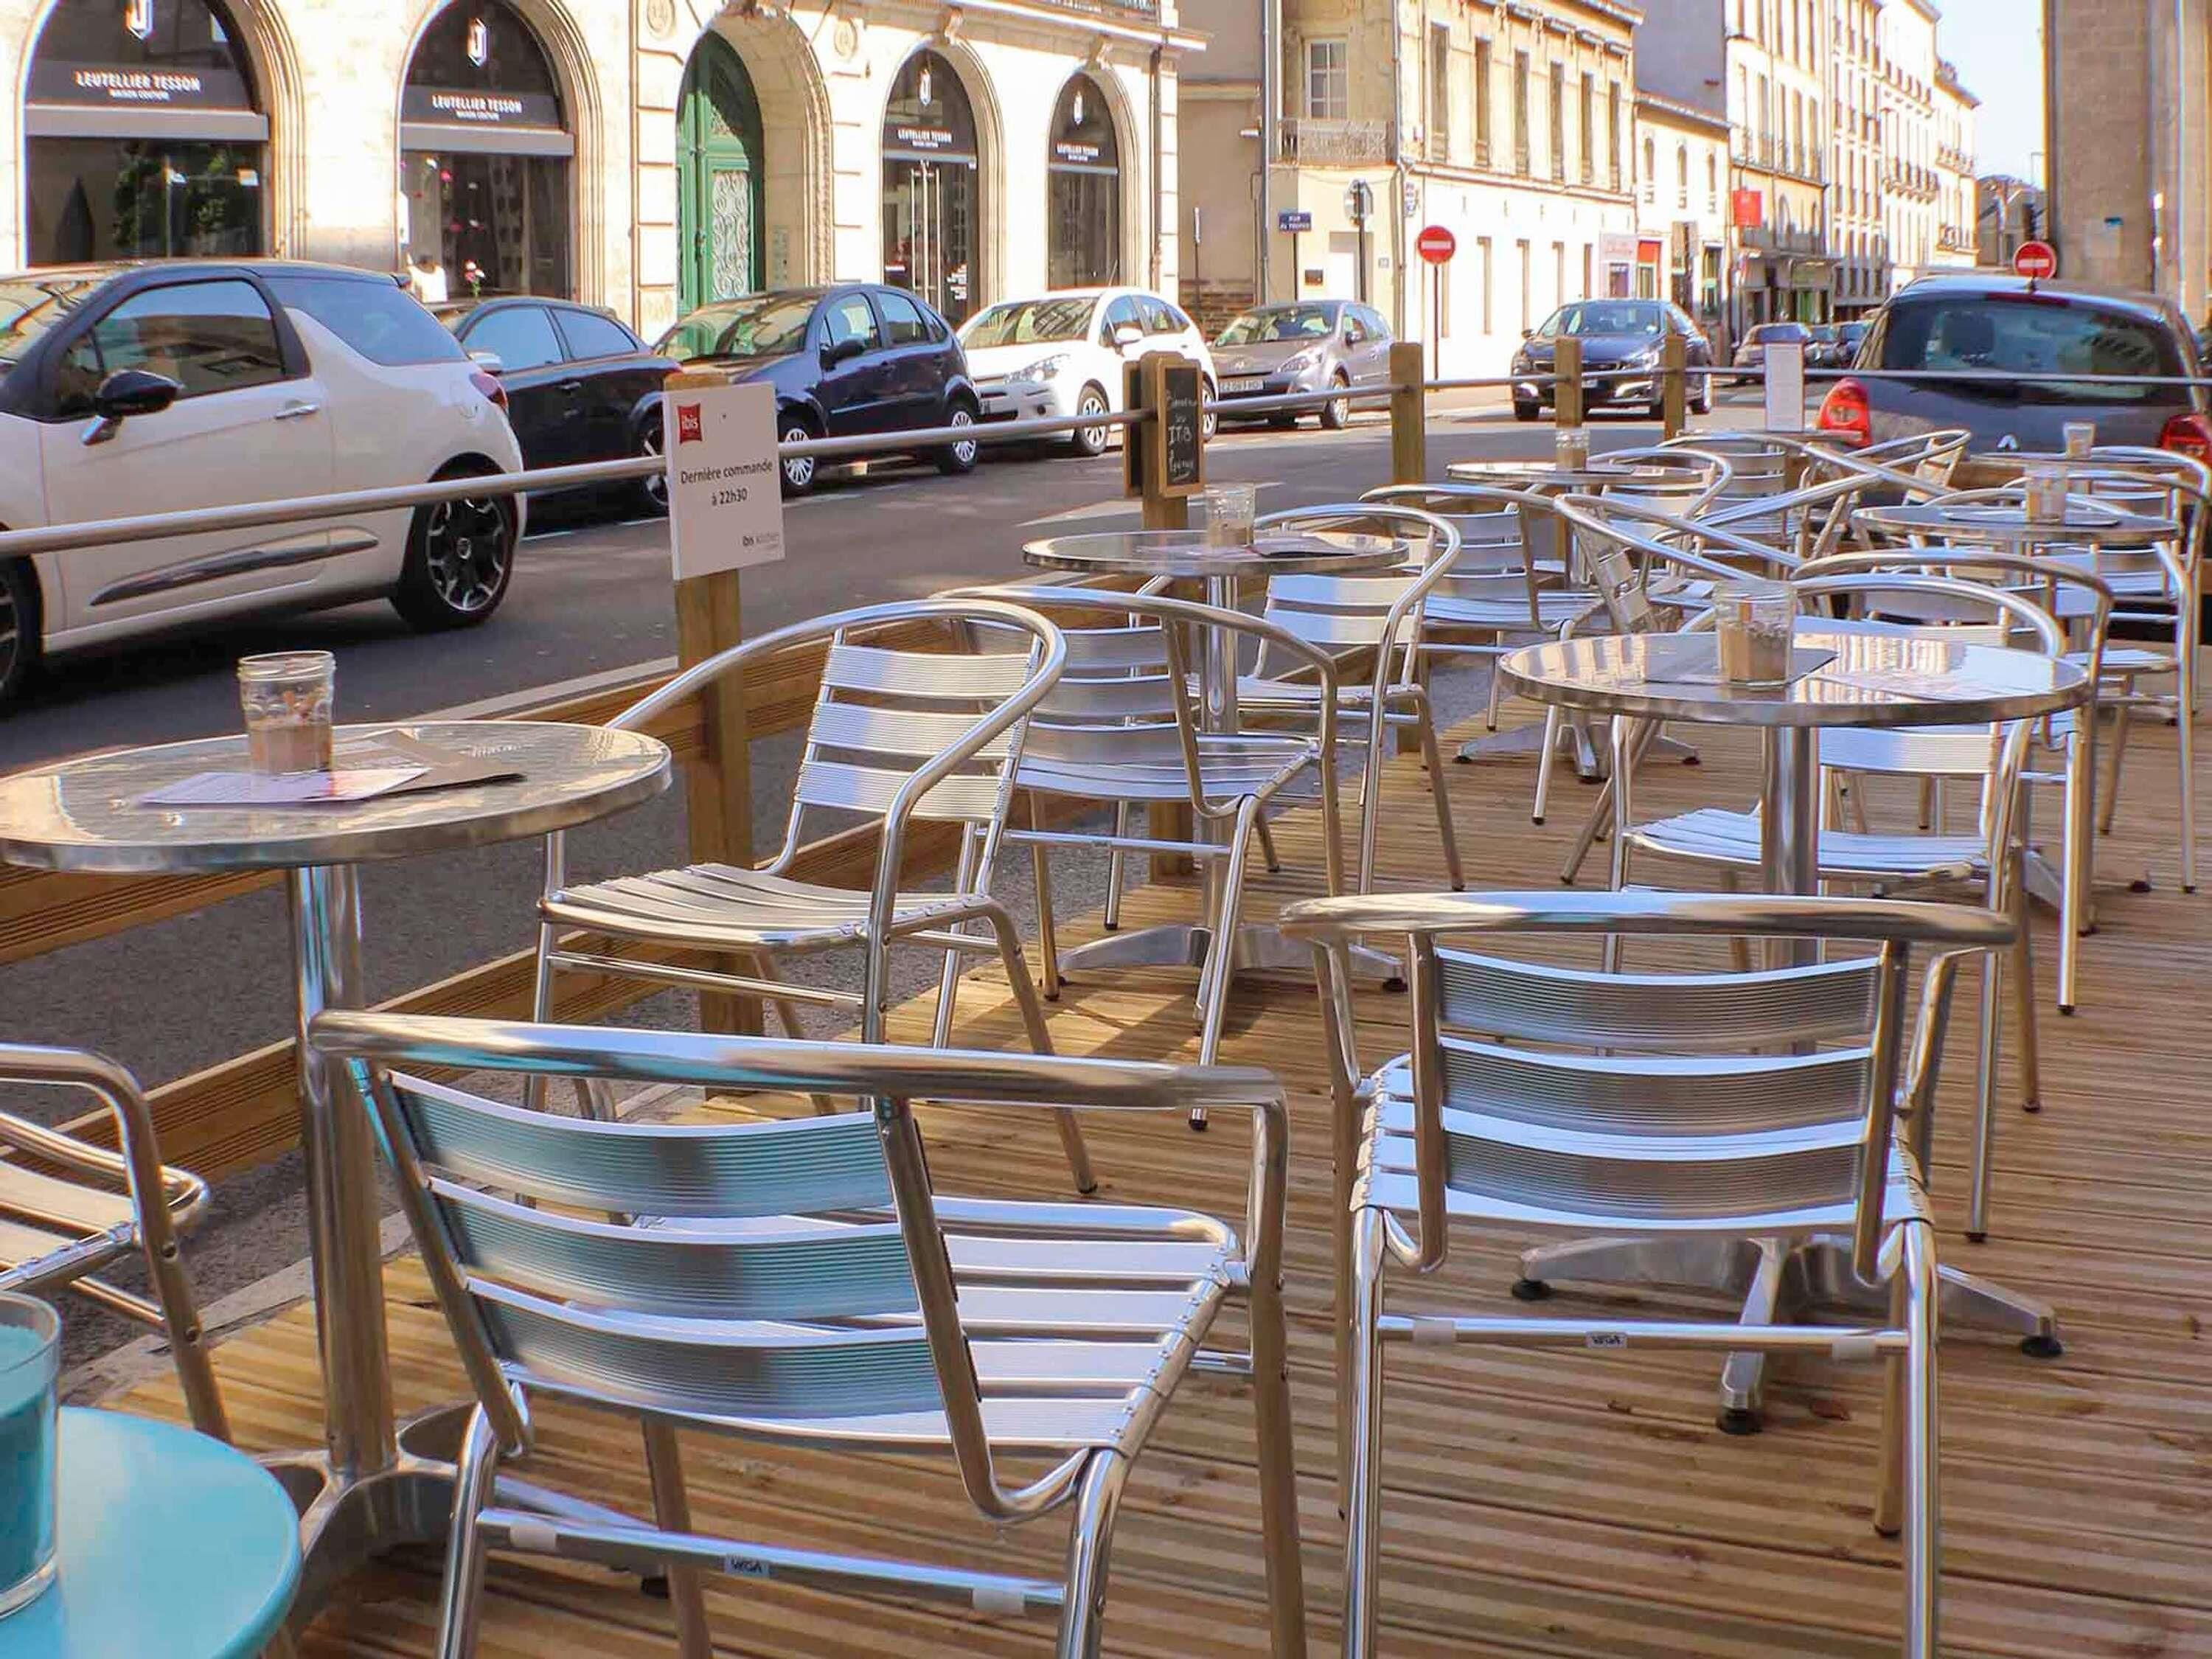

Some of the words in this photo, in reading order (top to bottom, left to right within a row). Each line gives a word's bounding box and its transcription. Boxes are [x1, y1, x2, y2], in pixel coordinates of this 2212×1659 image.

[74, 71, 151, 88] LEUTELLIER
[152, 74, 201, 91] TESSON
[432, 94, 487, 110] LEUTELLIER
[487, 97, 522, 113] TESSON
[681, 467, 721, 484] Dernière
[723, 459, 772, 479] commande
[711, 493, 717, 505] à
[719, 487, 748, 504] 22h30
